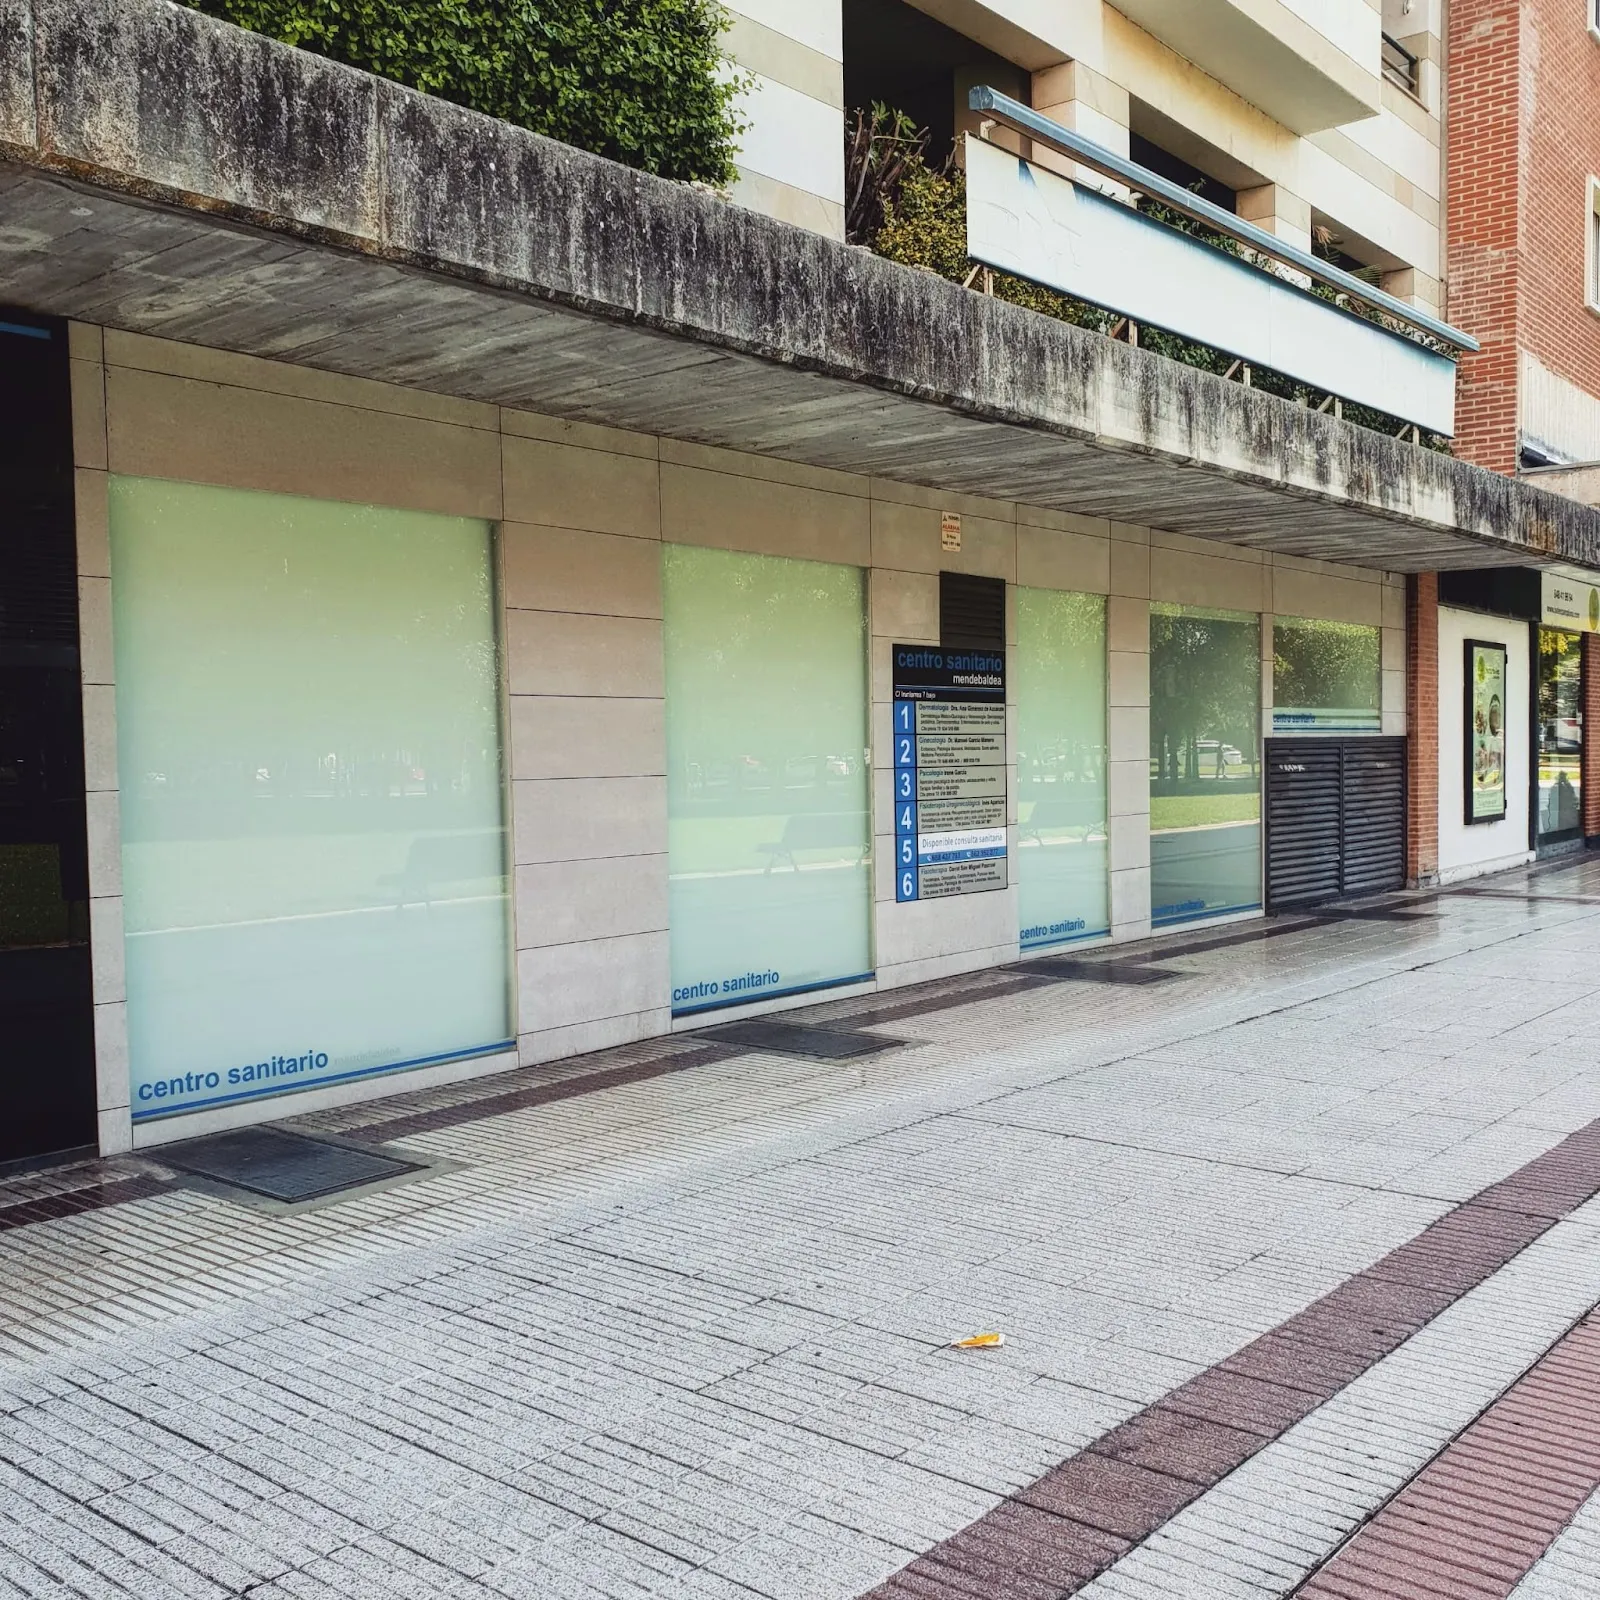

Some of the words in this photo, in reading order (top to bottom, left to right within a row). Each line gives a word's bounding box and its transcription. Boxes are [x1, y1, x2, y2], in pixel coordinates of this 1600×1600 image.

[898, 651, 942, 668] centro
[946, 652, 1003, 671] sanitario
[953, 674, 1002, 685] mendebaldea
[901, 706, 908, 729] 1
[900, 740, 911, 763] 2
[901, 773, 911, 796] 3
[901, 806, 912, 830] 4
[902, 839, 912, 863] 5
[922, 837, 954, 848] Disponible
[954, 835, 978, 845] consulta
[979, 833, 1003, 843] sanitaria
[903, 872, 913, 896] 6
[1020, 925, 1047, 939] centro
[1050, 917, 1086, 934] sanitario
[673, 980, 718, 1001] centro
[722, 969, 780, 993] sanitario
[138, 1071, 220, 1101] centro
[227, 1050, 329, 1084] sanitario
